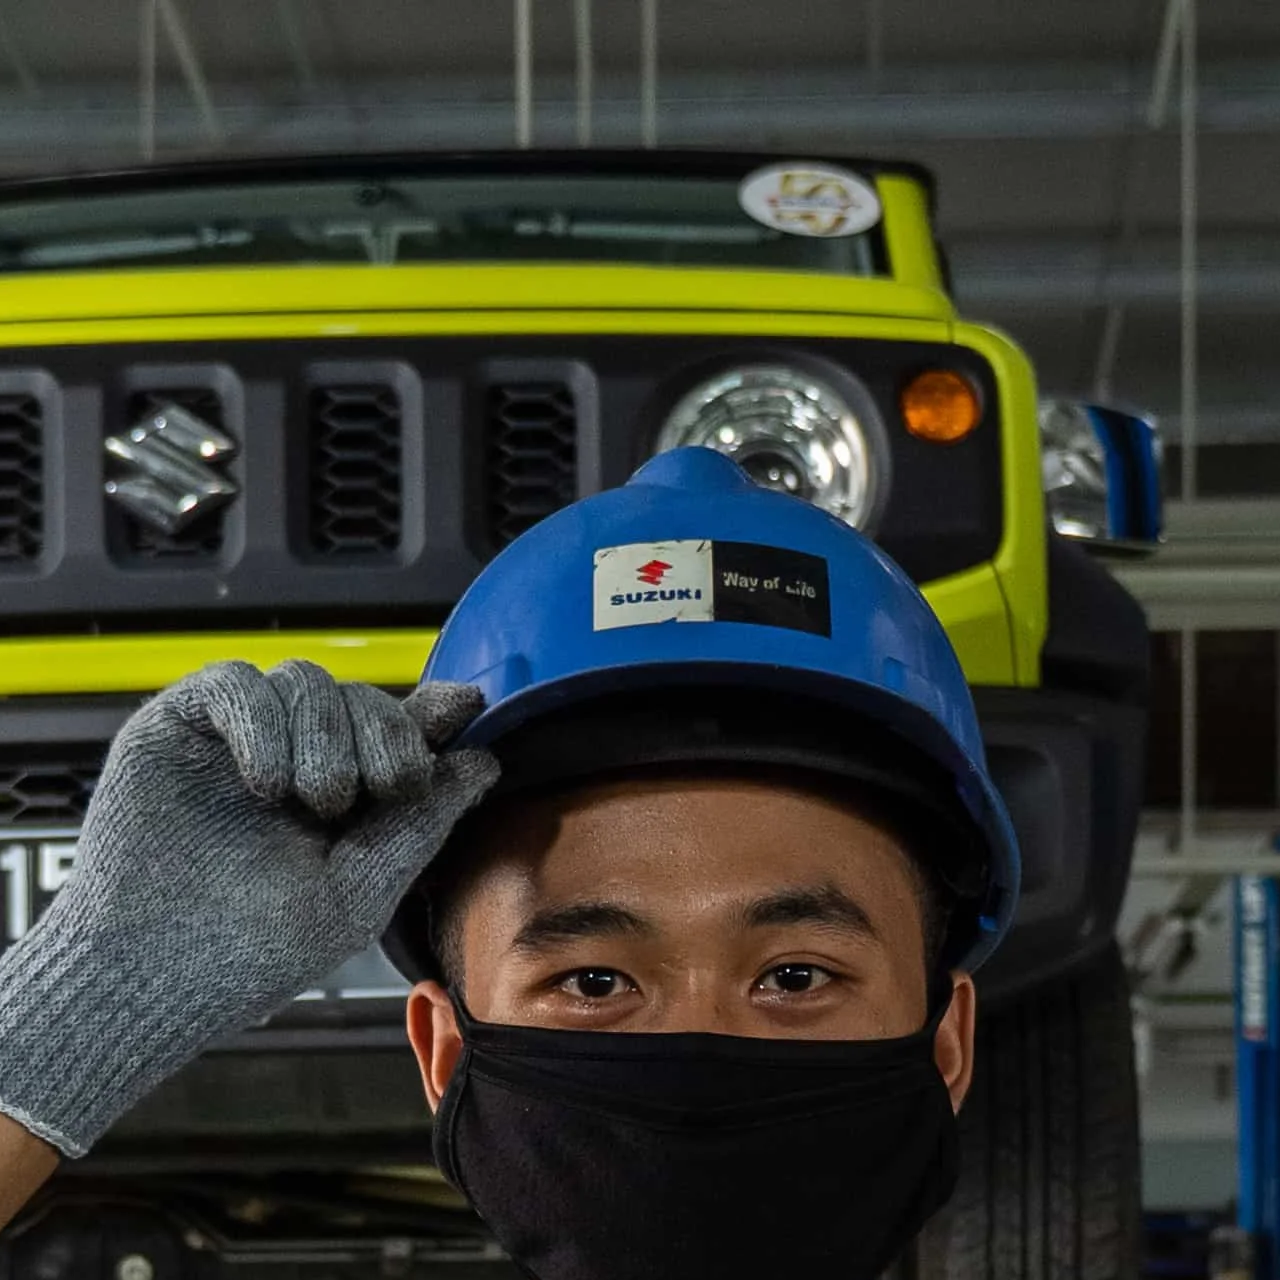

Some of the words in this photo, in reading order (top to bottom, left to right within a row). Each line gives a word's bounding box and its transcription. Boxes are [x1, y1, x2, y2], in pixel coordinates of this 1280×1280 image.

[723, 572, 758, 592] Way
[763, 576, 780, 590] of
[611, 588, 702, 606] SUZUKI
